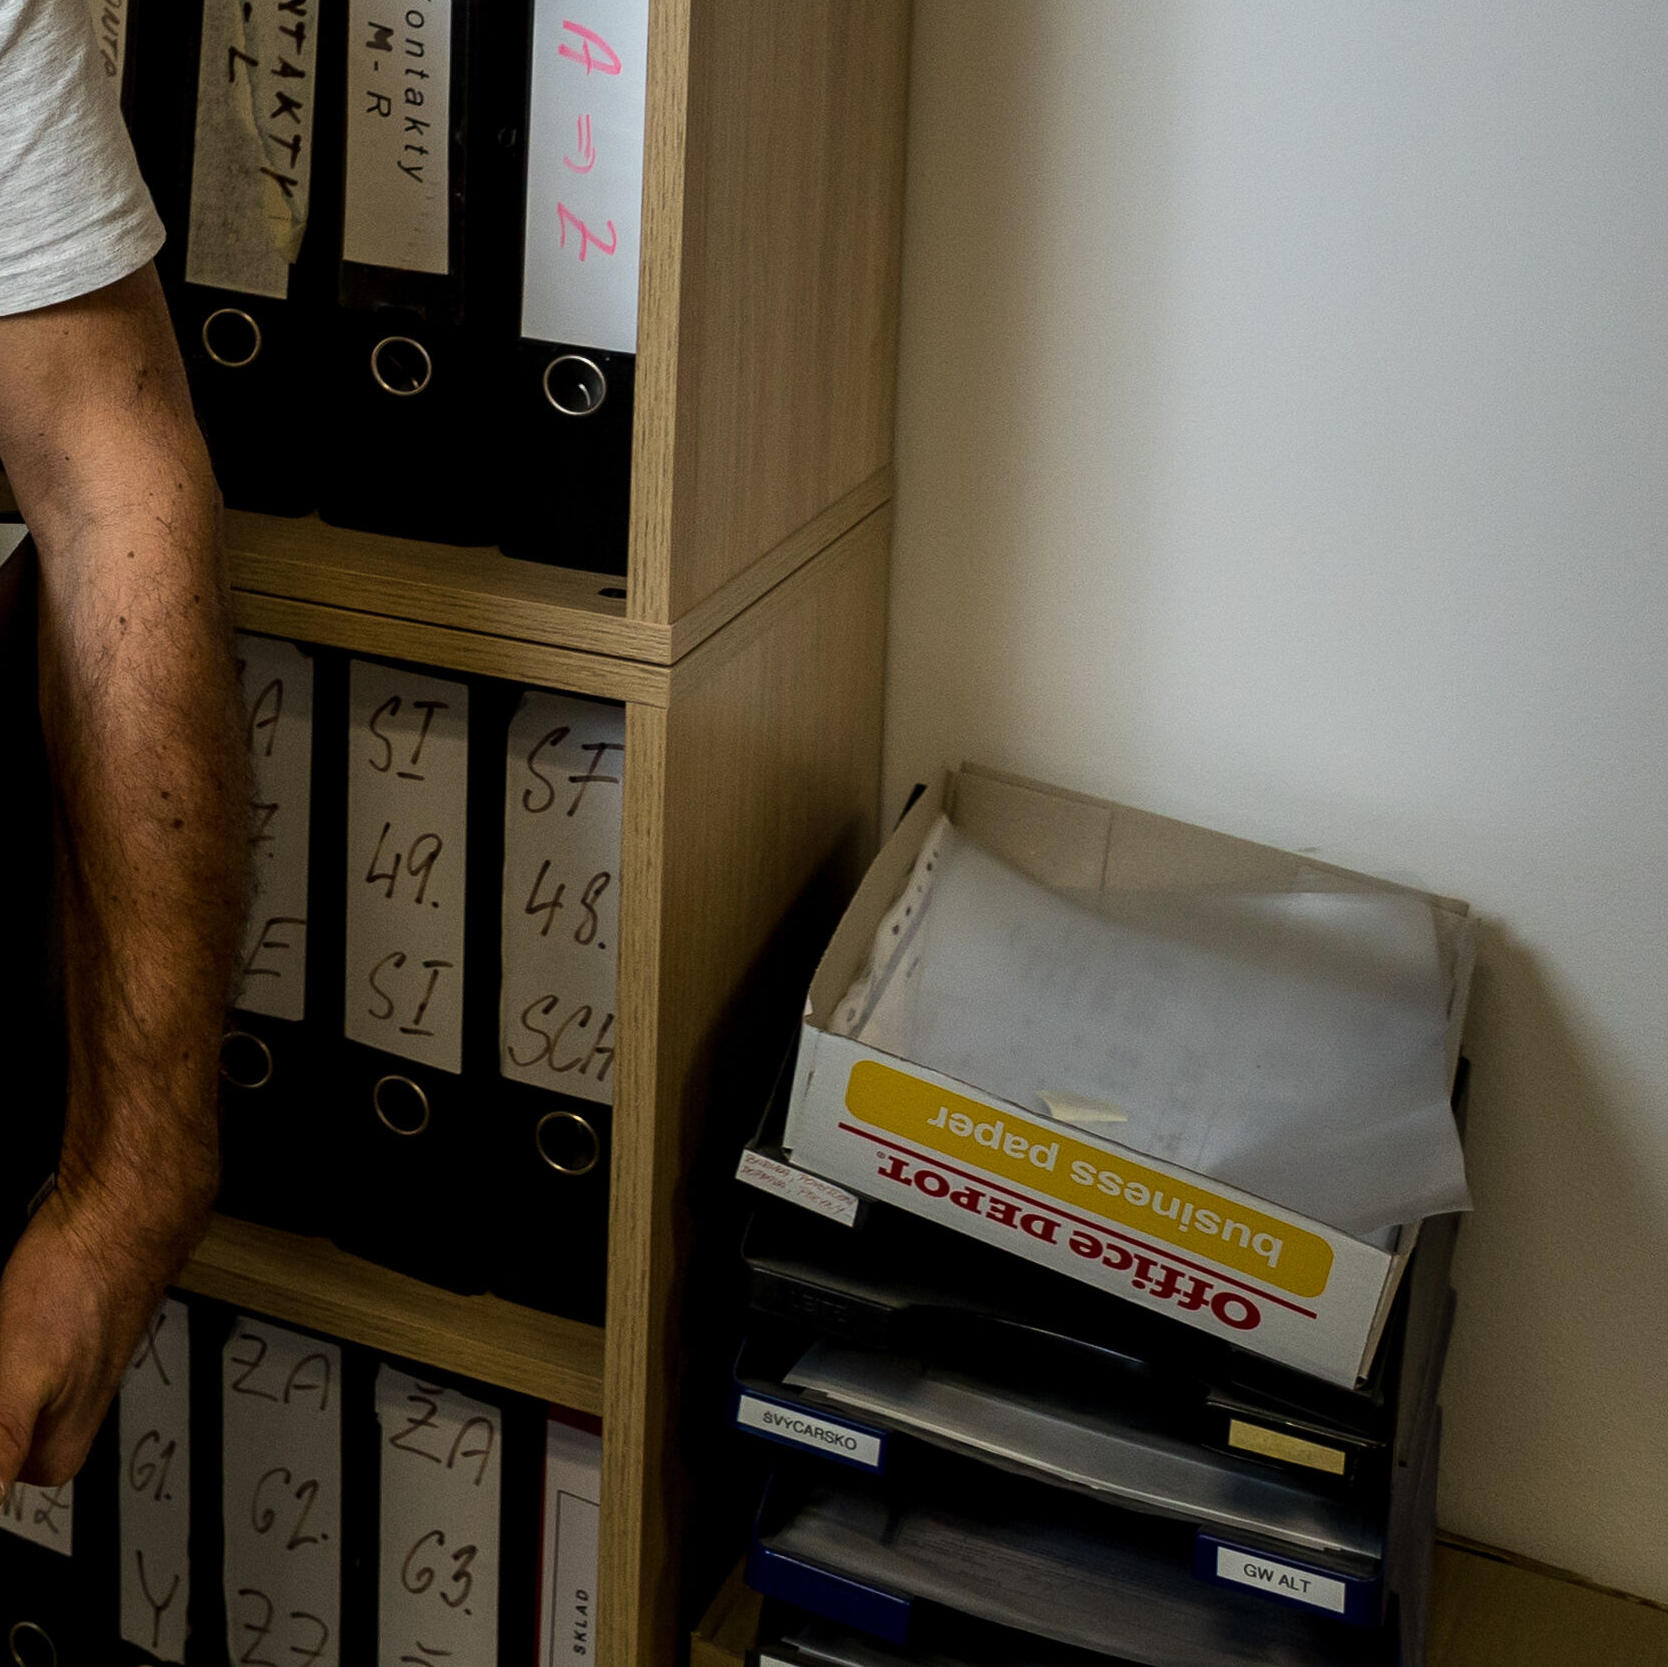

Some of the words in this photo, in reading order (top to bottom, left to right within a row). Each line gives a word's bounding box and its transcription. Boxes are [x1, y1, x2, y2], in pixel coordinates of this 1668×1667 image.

[235, 659, 283, 757] A
[365, 822, 443, 909] 49.
[525, 859, 611, 949] 48.
[243, 917, 306, 977] E
[927, 1105, 1060, 1173] paper
[877, 1155, 1059, 1245] DEPOT
[1069, 1159, 1284, 1269] business
[1069, 1230, 1262, 1331] Office
[230, 1334, 332, 1412] ZA
[129, 1430, 176, 1502] 61.
[251, 1467, 329, 1551] 62.
[136, 1550, 179, 1648] Y
[400, 1529, 479, 1616] 63.
[1244, 1563, 1273, 1582] GW
[1279, 1575, 1311, 1592] ALT
[573, 1589, 590, 1655] SKLAD
